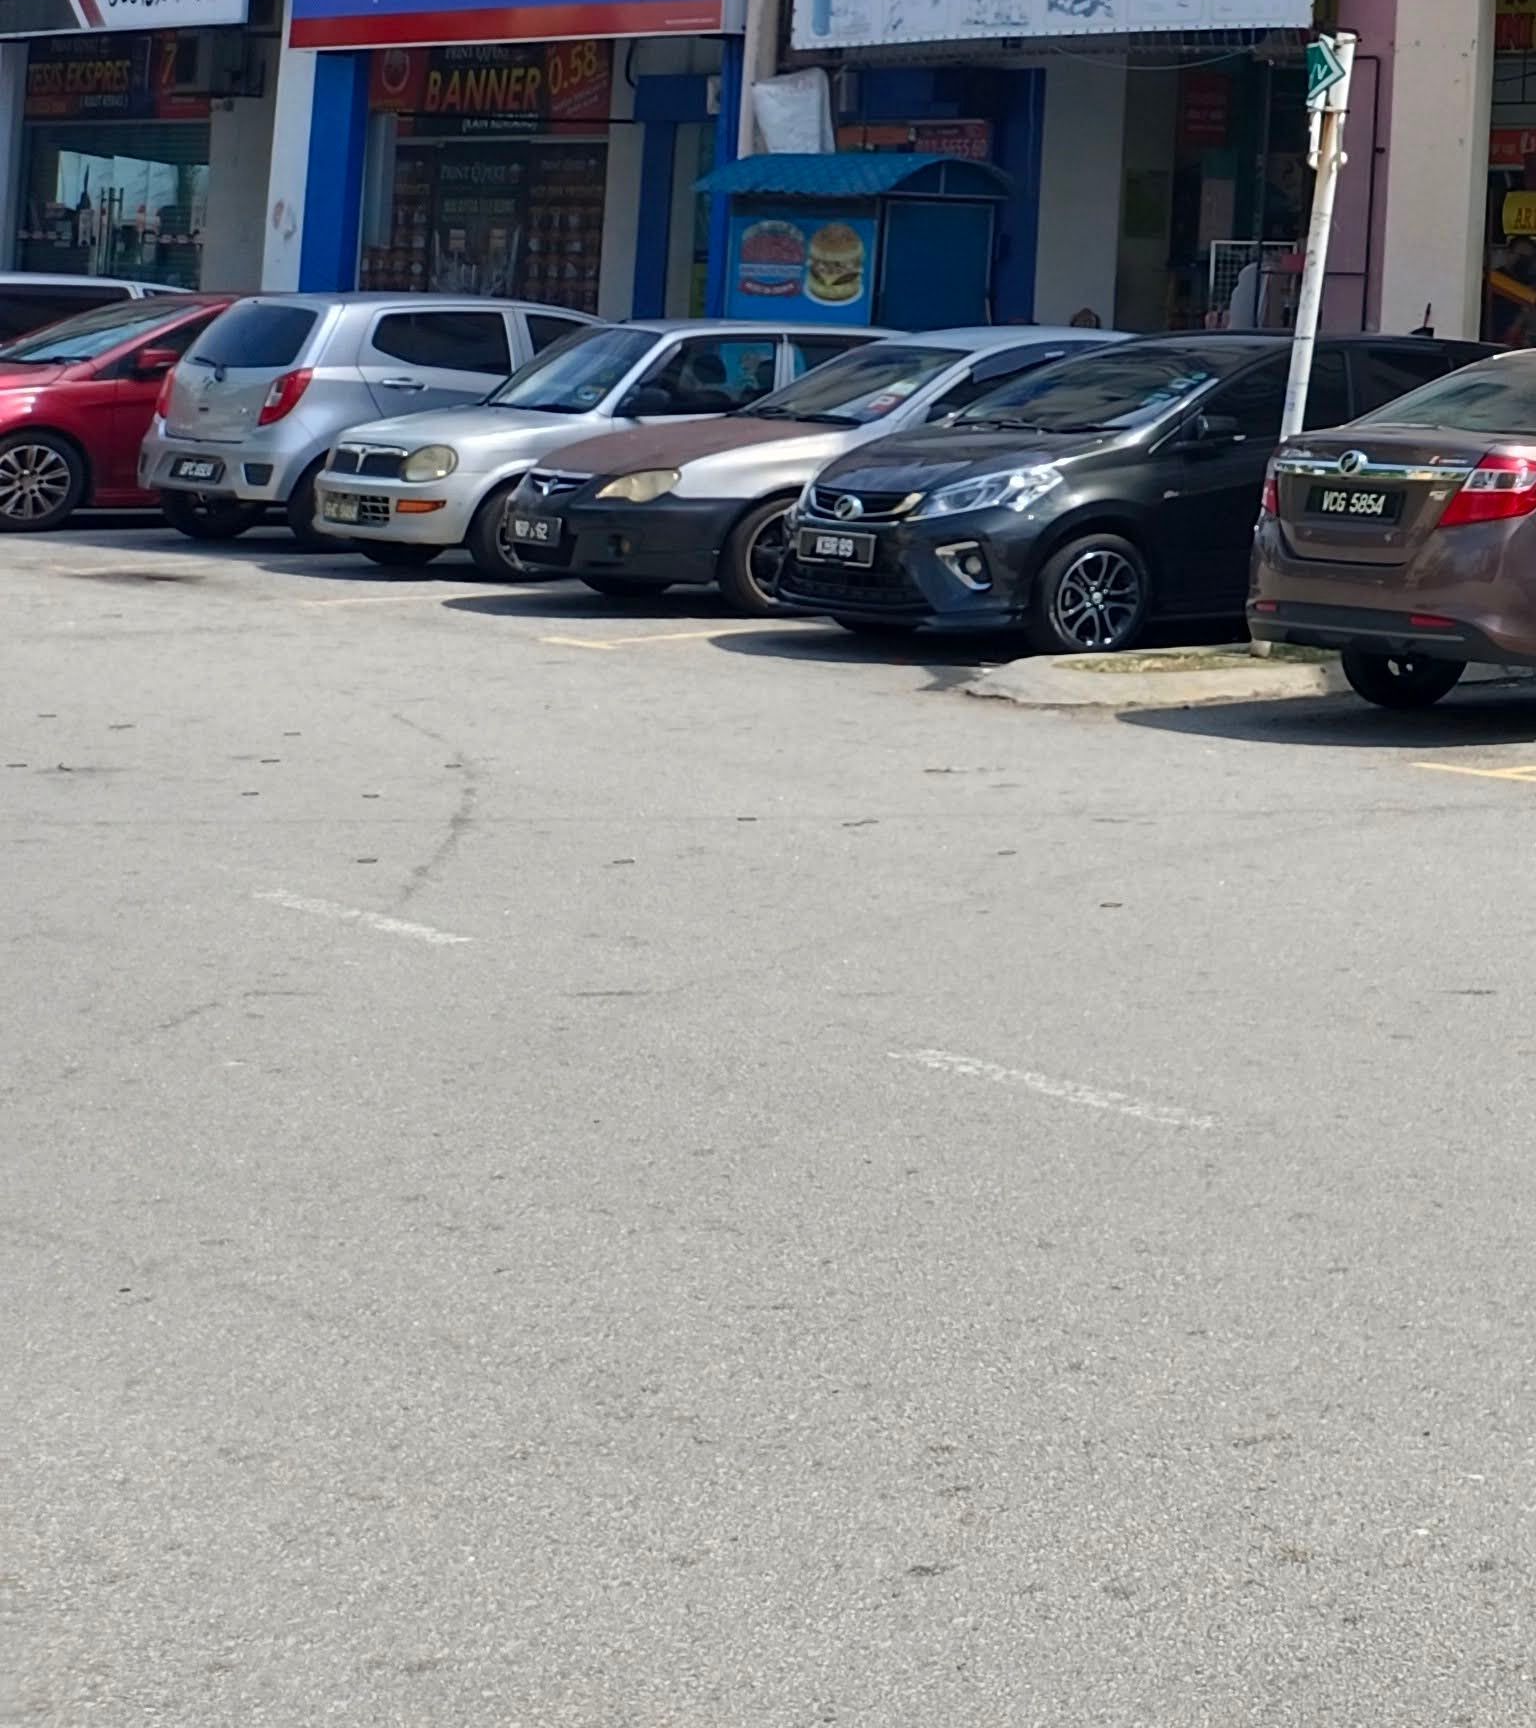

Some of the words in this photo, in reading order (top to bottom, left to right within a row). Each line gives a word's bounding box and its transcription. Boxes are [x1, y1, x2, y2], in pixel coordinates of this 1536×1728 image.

[424, 67, 542, 112] BANNER
[548, 42, 598, 95] 0.58
[1321, 490, 1346, 513] VCG
[1350, 493, 1386, 515] 5854
